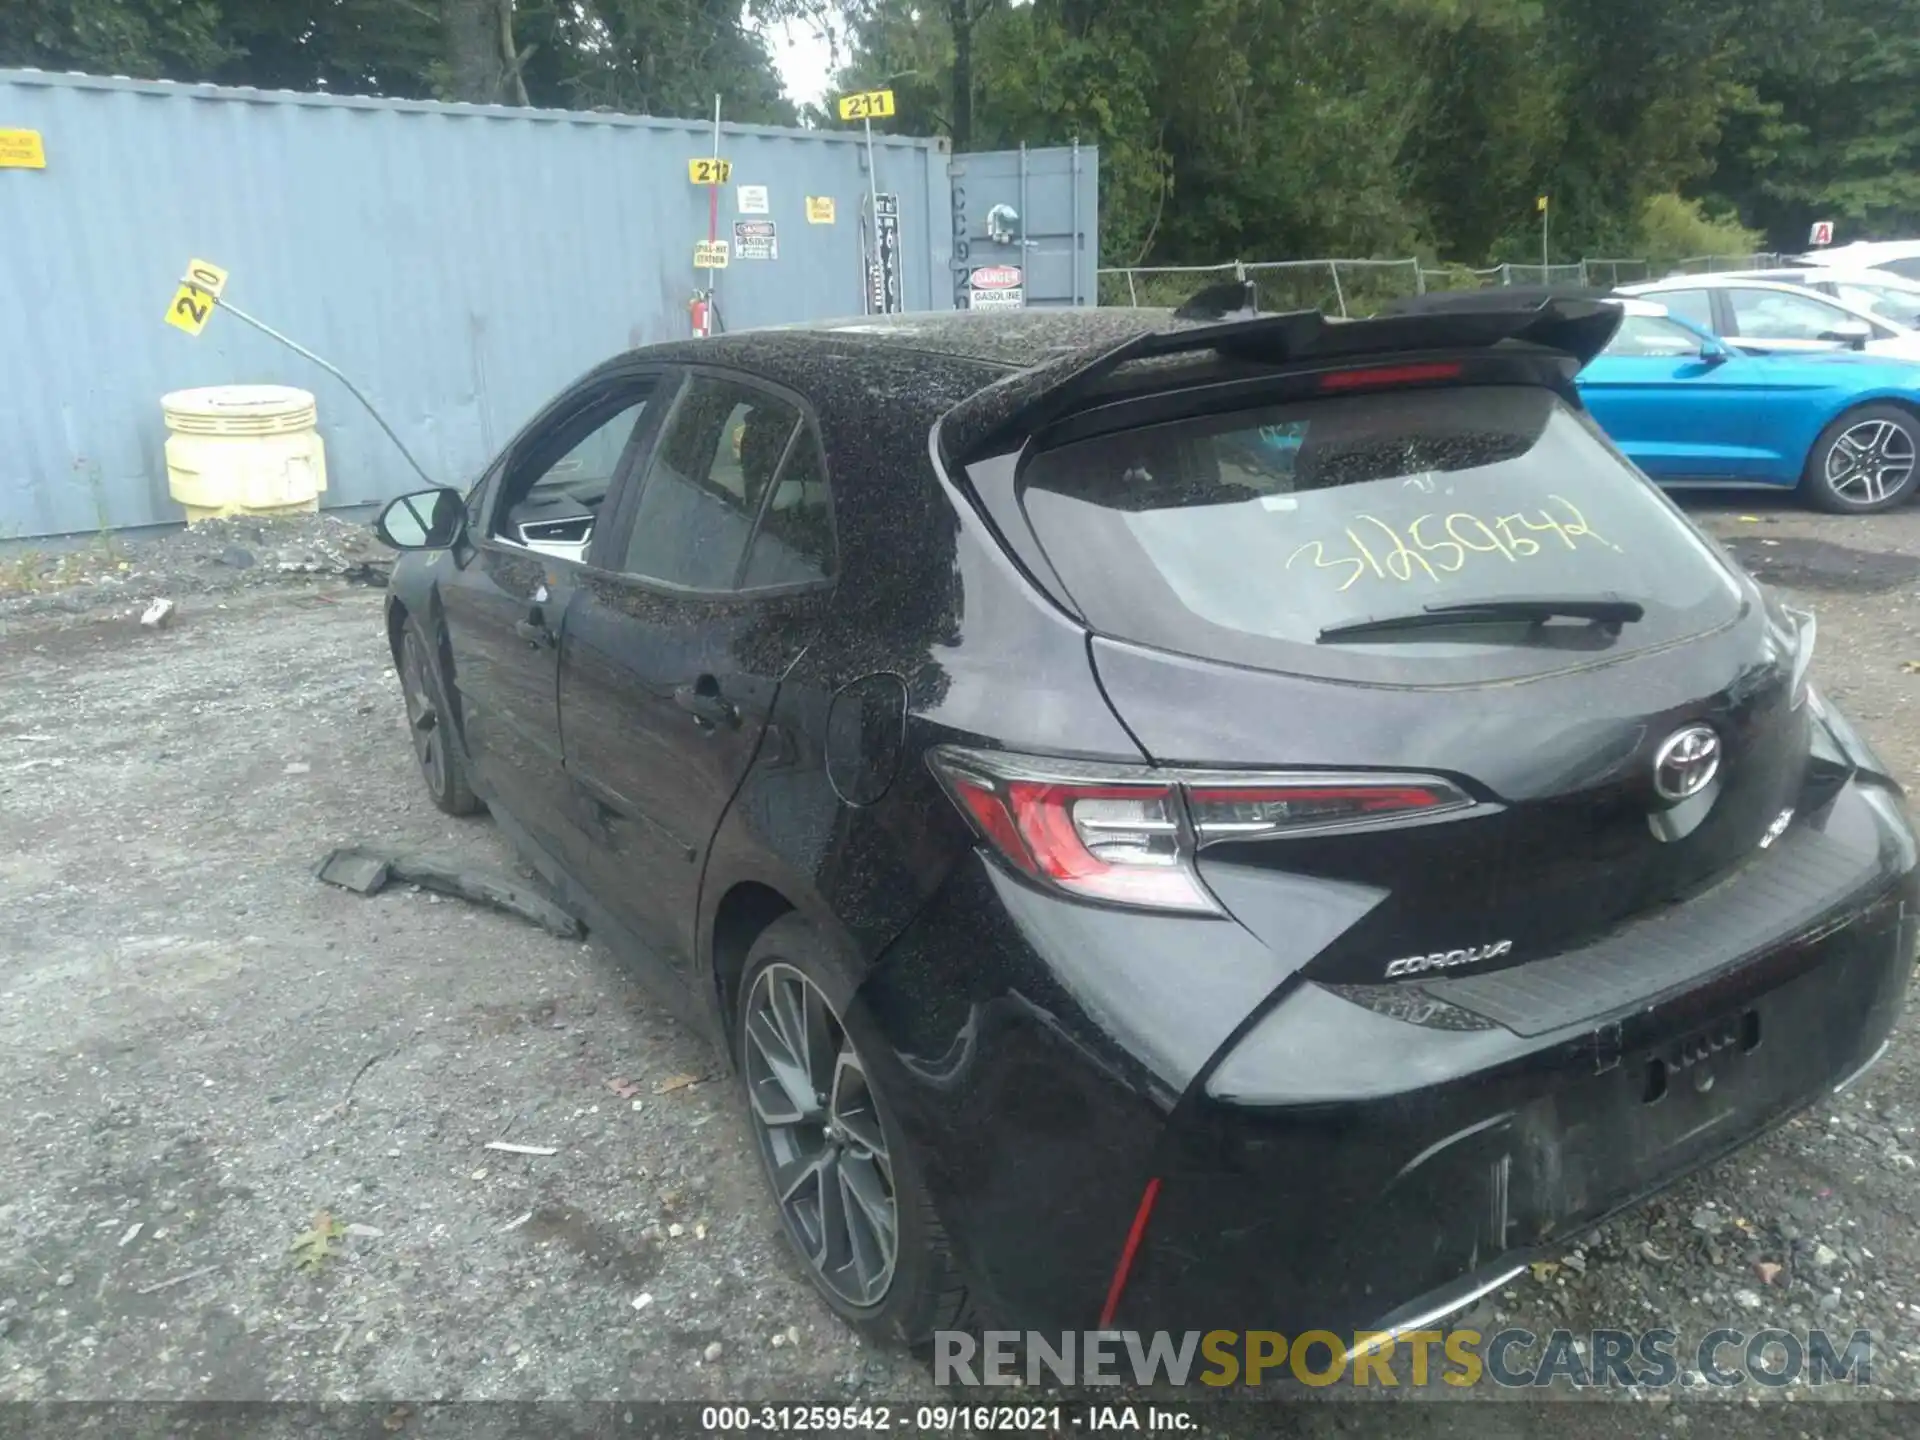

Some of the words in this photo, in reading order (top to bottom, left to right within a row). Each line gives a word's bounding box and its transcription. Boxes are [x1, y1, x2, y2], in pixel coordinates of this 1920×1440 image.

[847, 94, 885, 117] 211
[1815, 223, 1830, 242] A
[975, 291, 1021, 301] GASOLINE
[1286, 494, 1624, 592] 31259542
[1384, 940, 1513, 978] COROLLA
